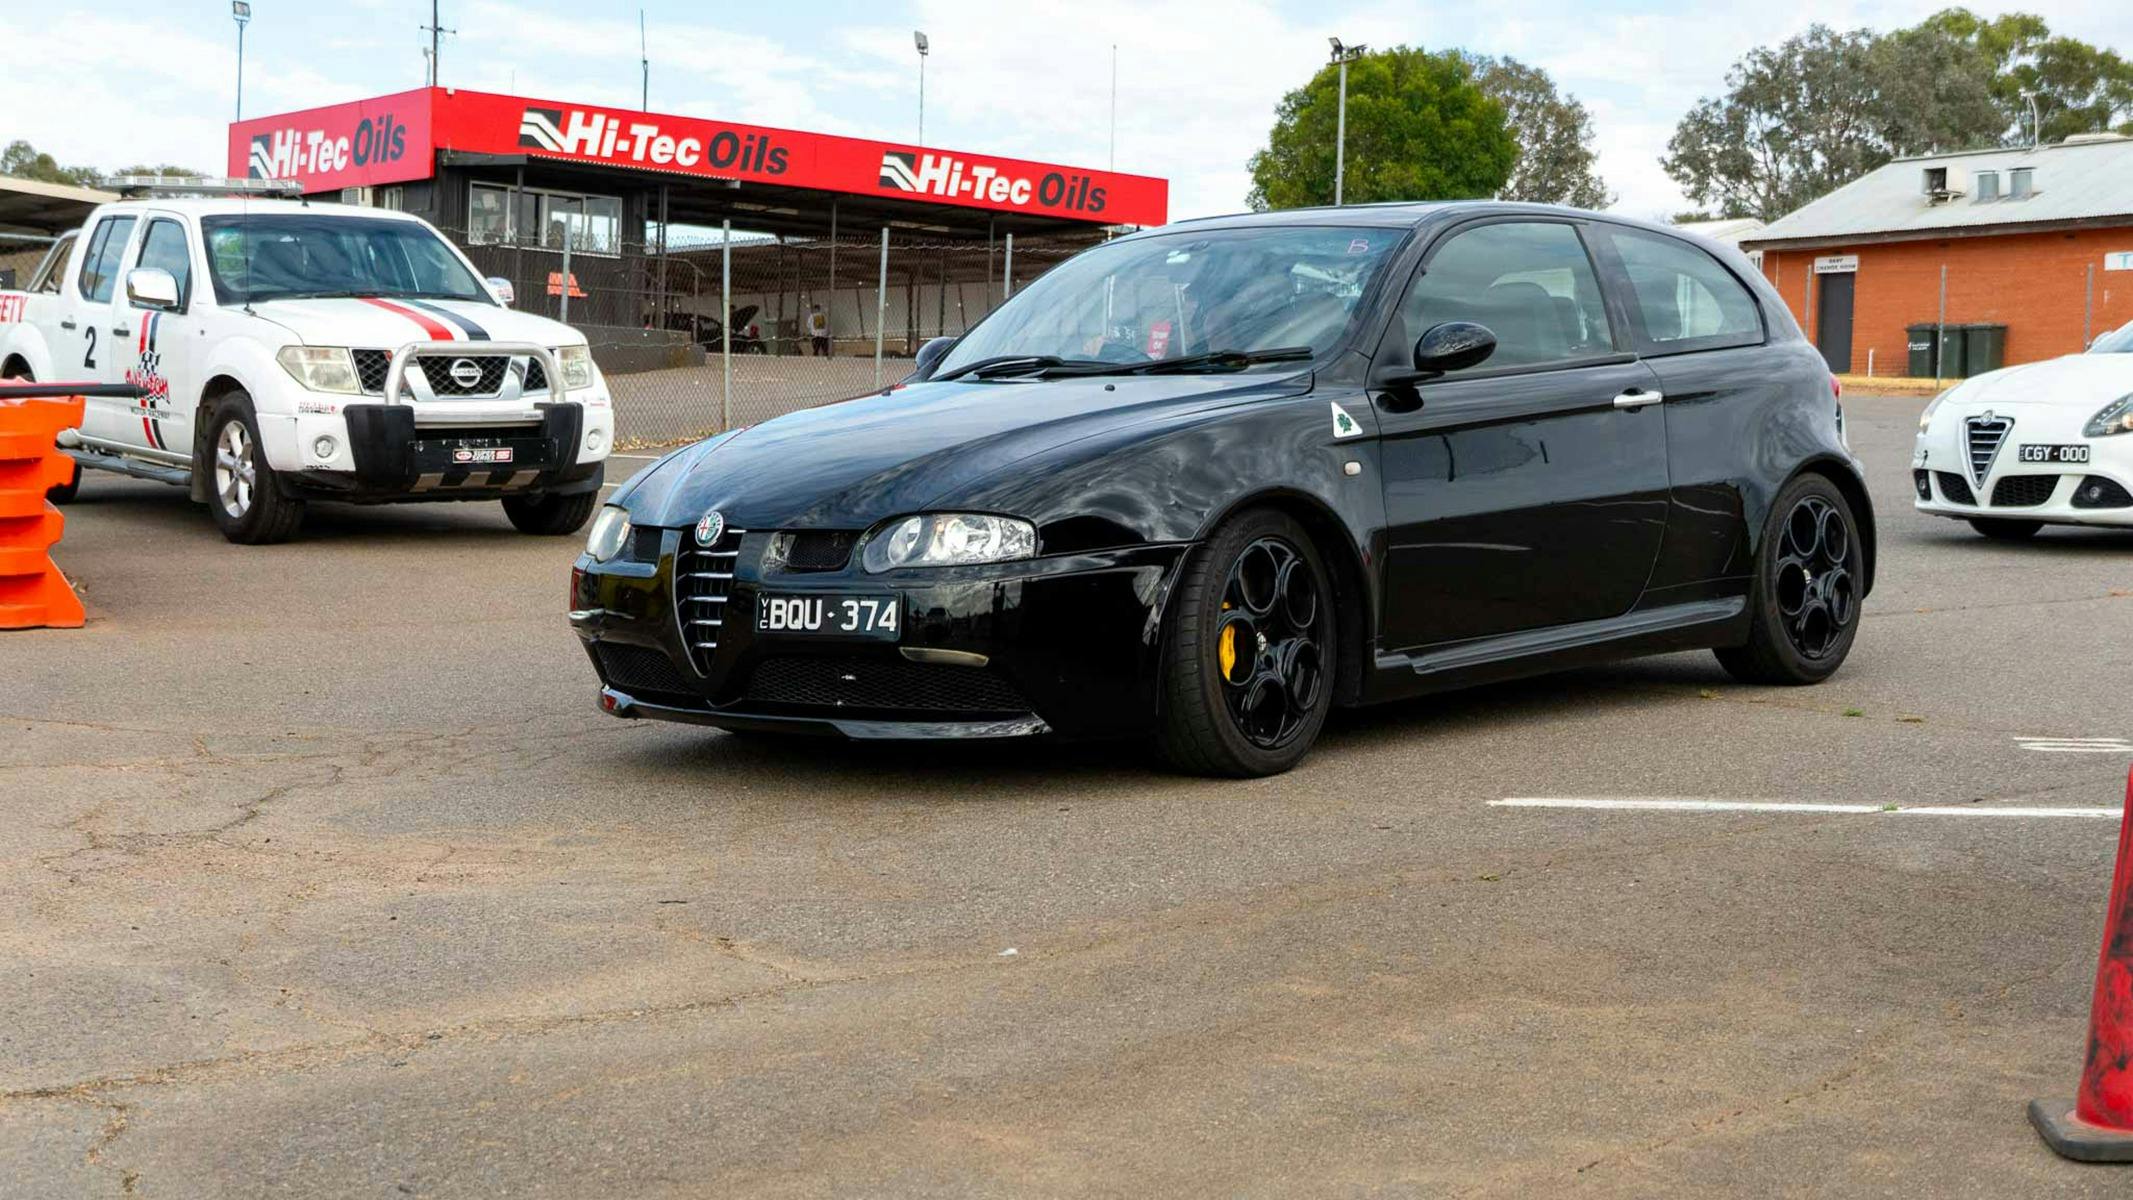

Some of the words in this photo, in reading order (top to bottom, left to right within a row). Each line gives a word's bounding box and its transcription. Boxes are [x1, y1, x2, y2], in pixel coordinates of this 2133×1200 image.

[271, 128, 350, 178] Hi-Tec
[353, 113, 406, 167] Oils
[563, 110, 701, 167] Hi-Tec
[707, 130, 790, 175] Oils
[914, 153, 1032, 205] Hi-Tec
[1037, 171, 1108, 213] Oils
[84, 326, 97, 369] 2
[759, 598, 770, 629] VIC
